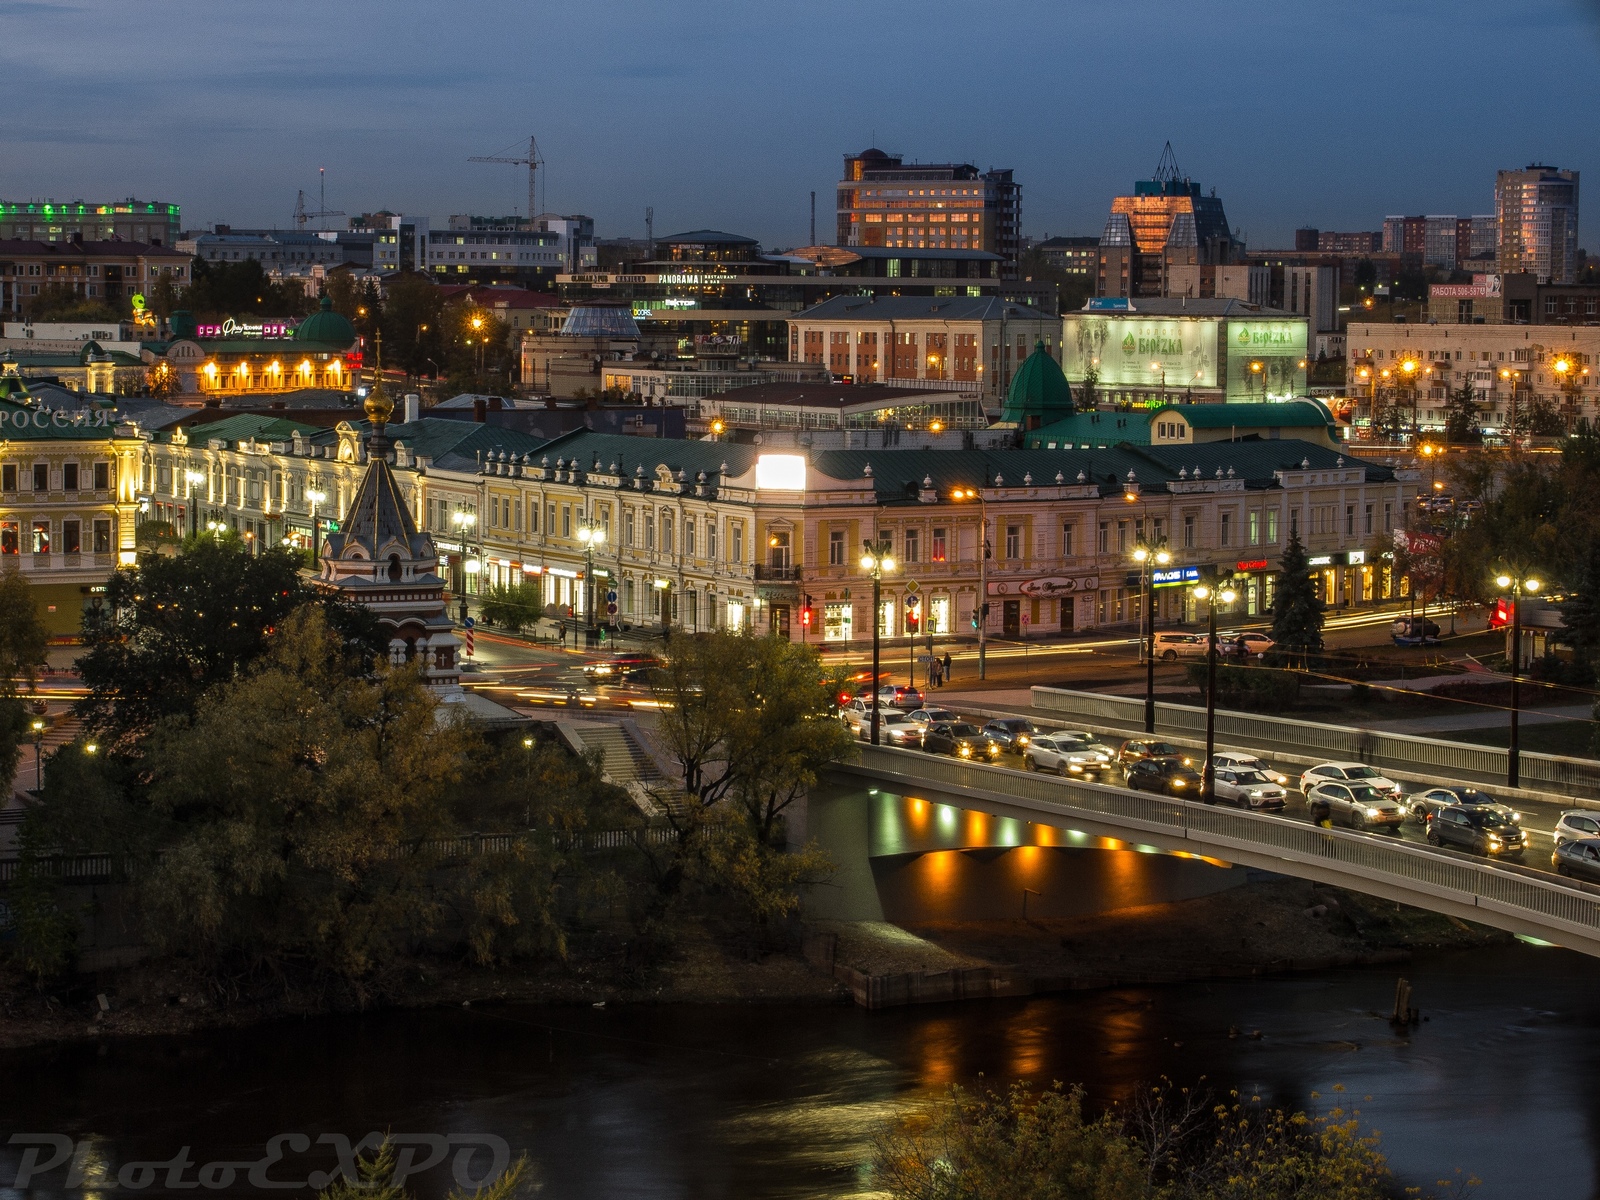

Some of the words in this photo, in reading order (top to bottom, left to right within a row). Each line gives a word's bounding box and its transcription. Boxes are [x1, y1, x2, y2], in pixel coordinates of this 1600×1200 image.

[658, 274, 699, 284] PANORAMA
[1432, 287, 1457, 295] РАБОТА
[1138, 328, 1182, 336] ЗОЛОТО
[0, 410, 109, 428] РОССИЯ
